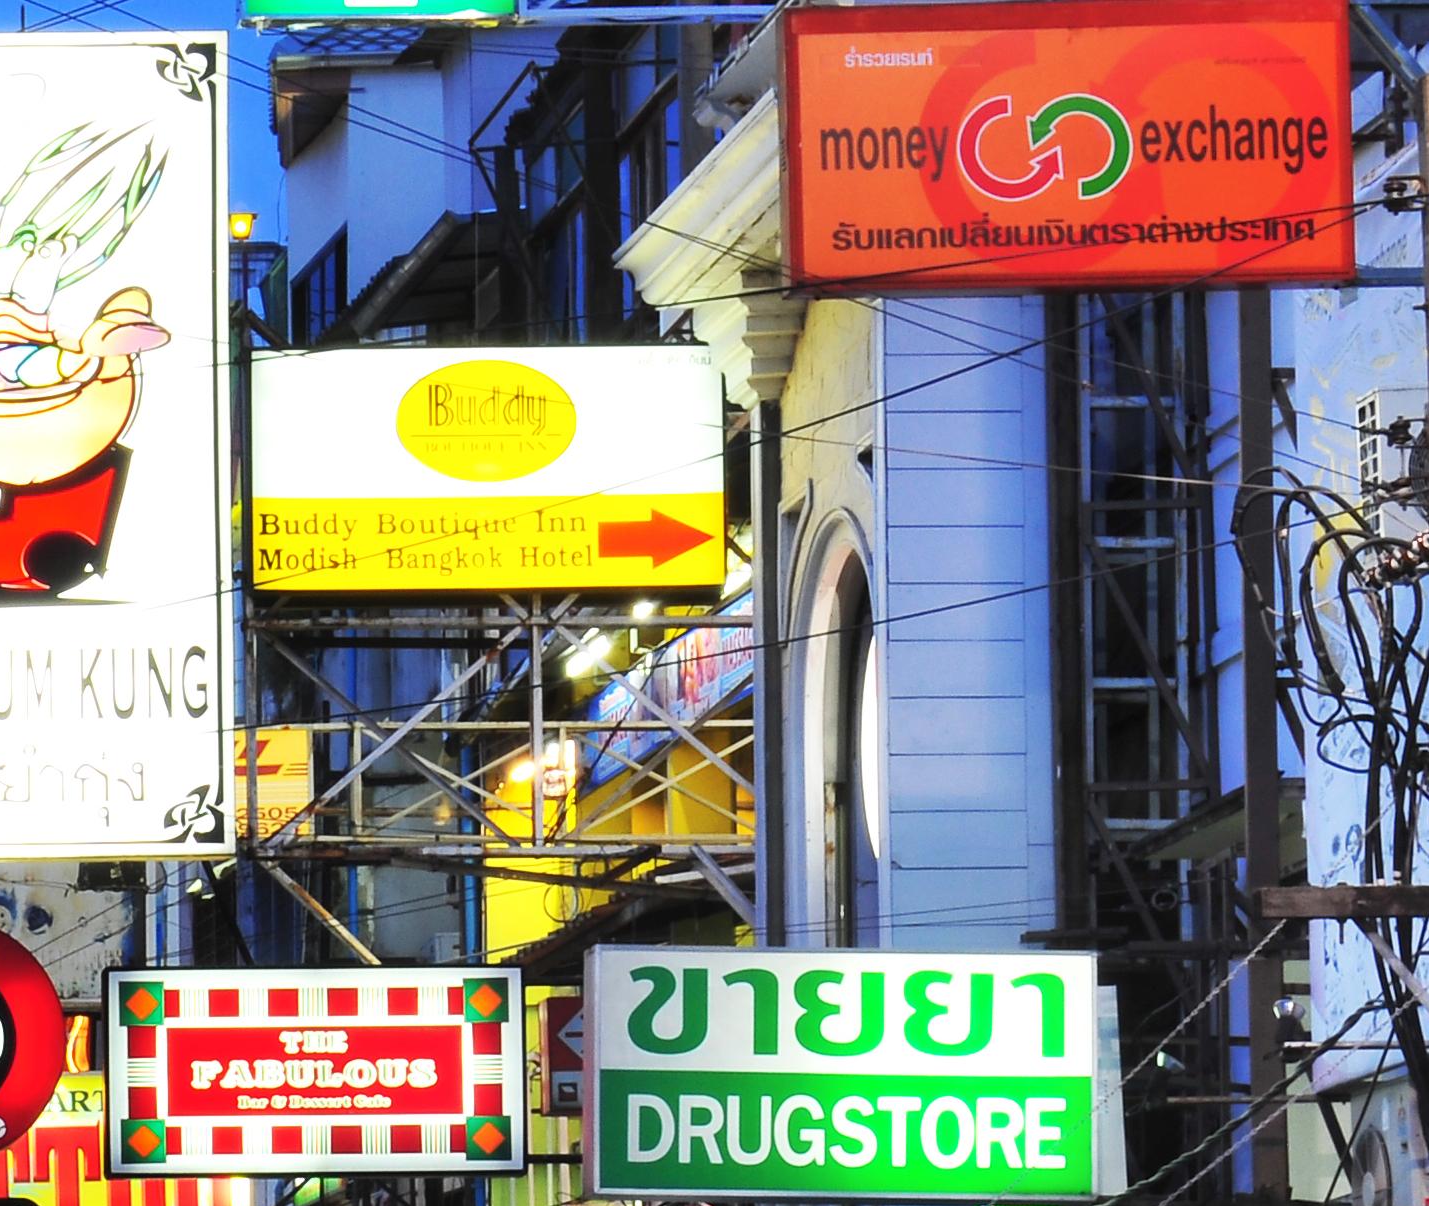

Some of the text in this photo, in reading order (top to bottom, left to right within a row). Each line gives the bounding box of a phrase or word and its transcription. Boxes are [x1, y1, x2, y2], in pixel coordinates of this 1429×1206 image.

[820, 105, 1327, 182] money exchange
[428, 383, 546, 437] Buddy
[258, 509, 587, 543] Buddy Boutique Inn
[258, 544, 594, 576] Modish Bangkok Hotel
[79, 645, 210, 719] KUNG
[627, 965, 1067, 1059] ขายยา
[278, 1030, 349, 1054] THE
[190, 1058, 439, 1090] FABULOUS
[626, 1092, 1068, 1170] DRUGSTORE
